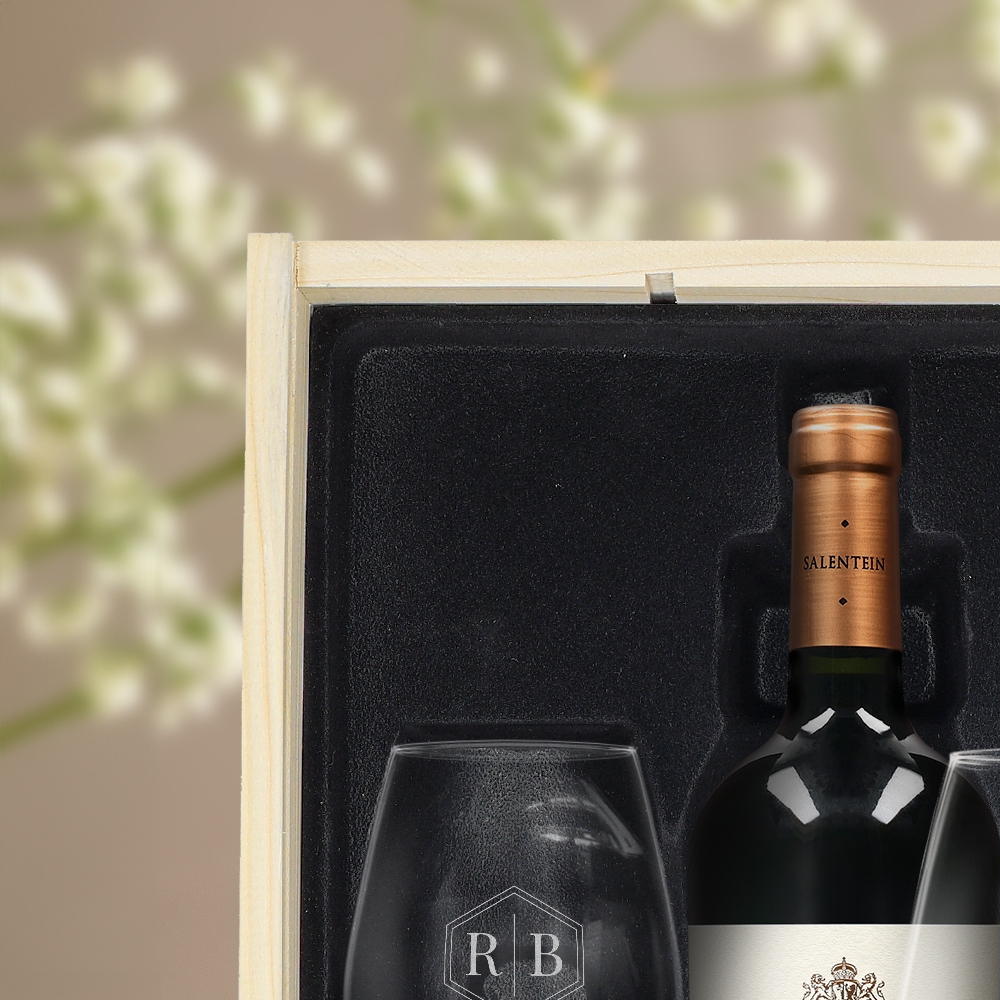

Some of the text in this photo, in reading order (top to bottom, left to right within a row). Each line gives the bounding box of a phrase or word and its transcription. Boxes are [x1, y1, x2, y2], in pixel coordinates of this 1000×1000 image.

[803, 555, 886, 571] SALENTEIN
[466, 932, 562, 977] R B
